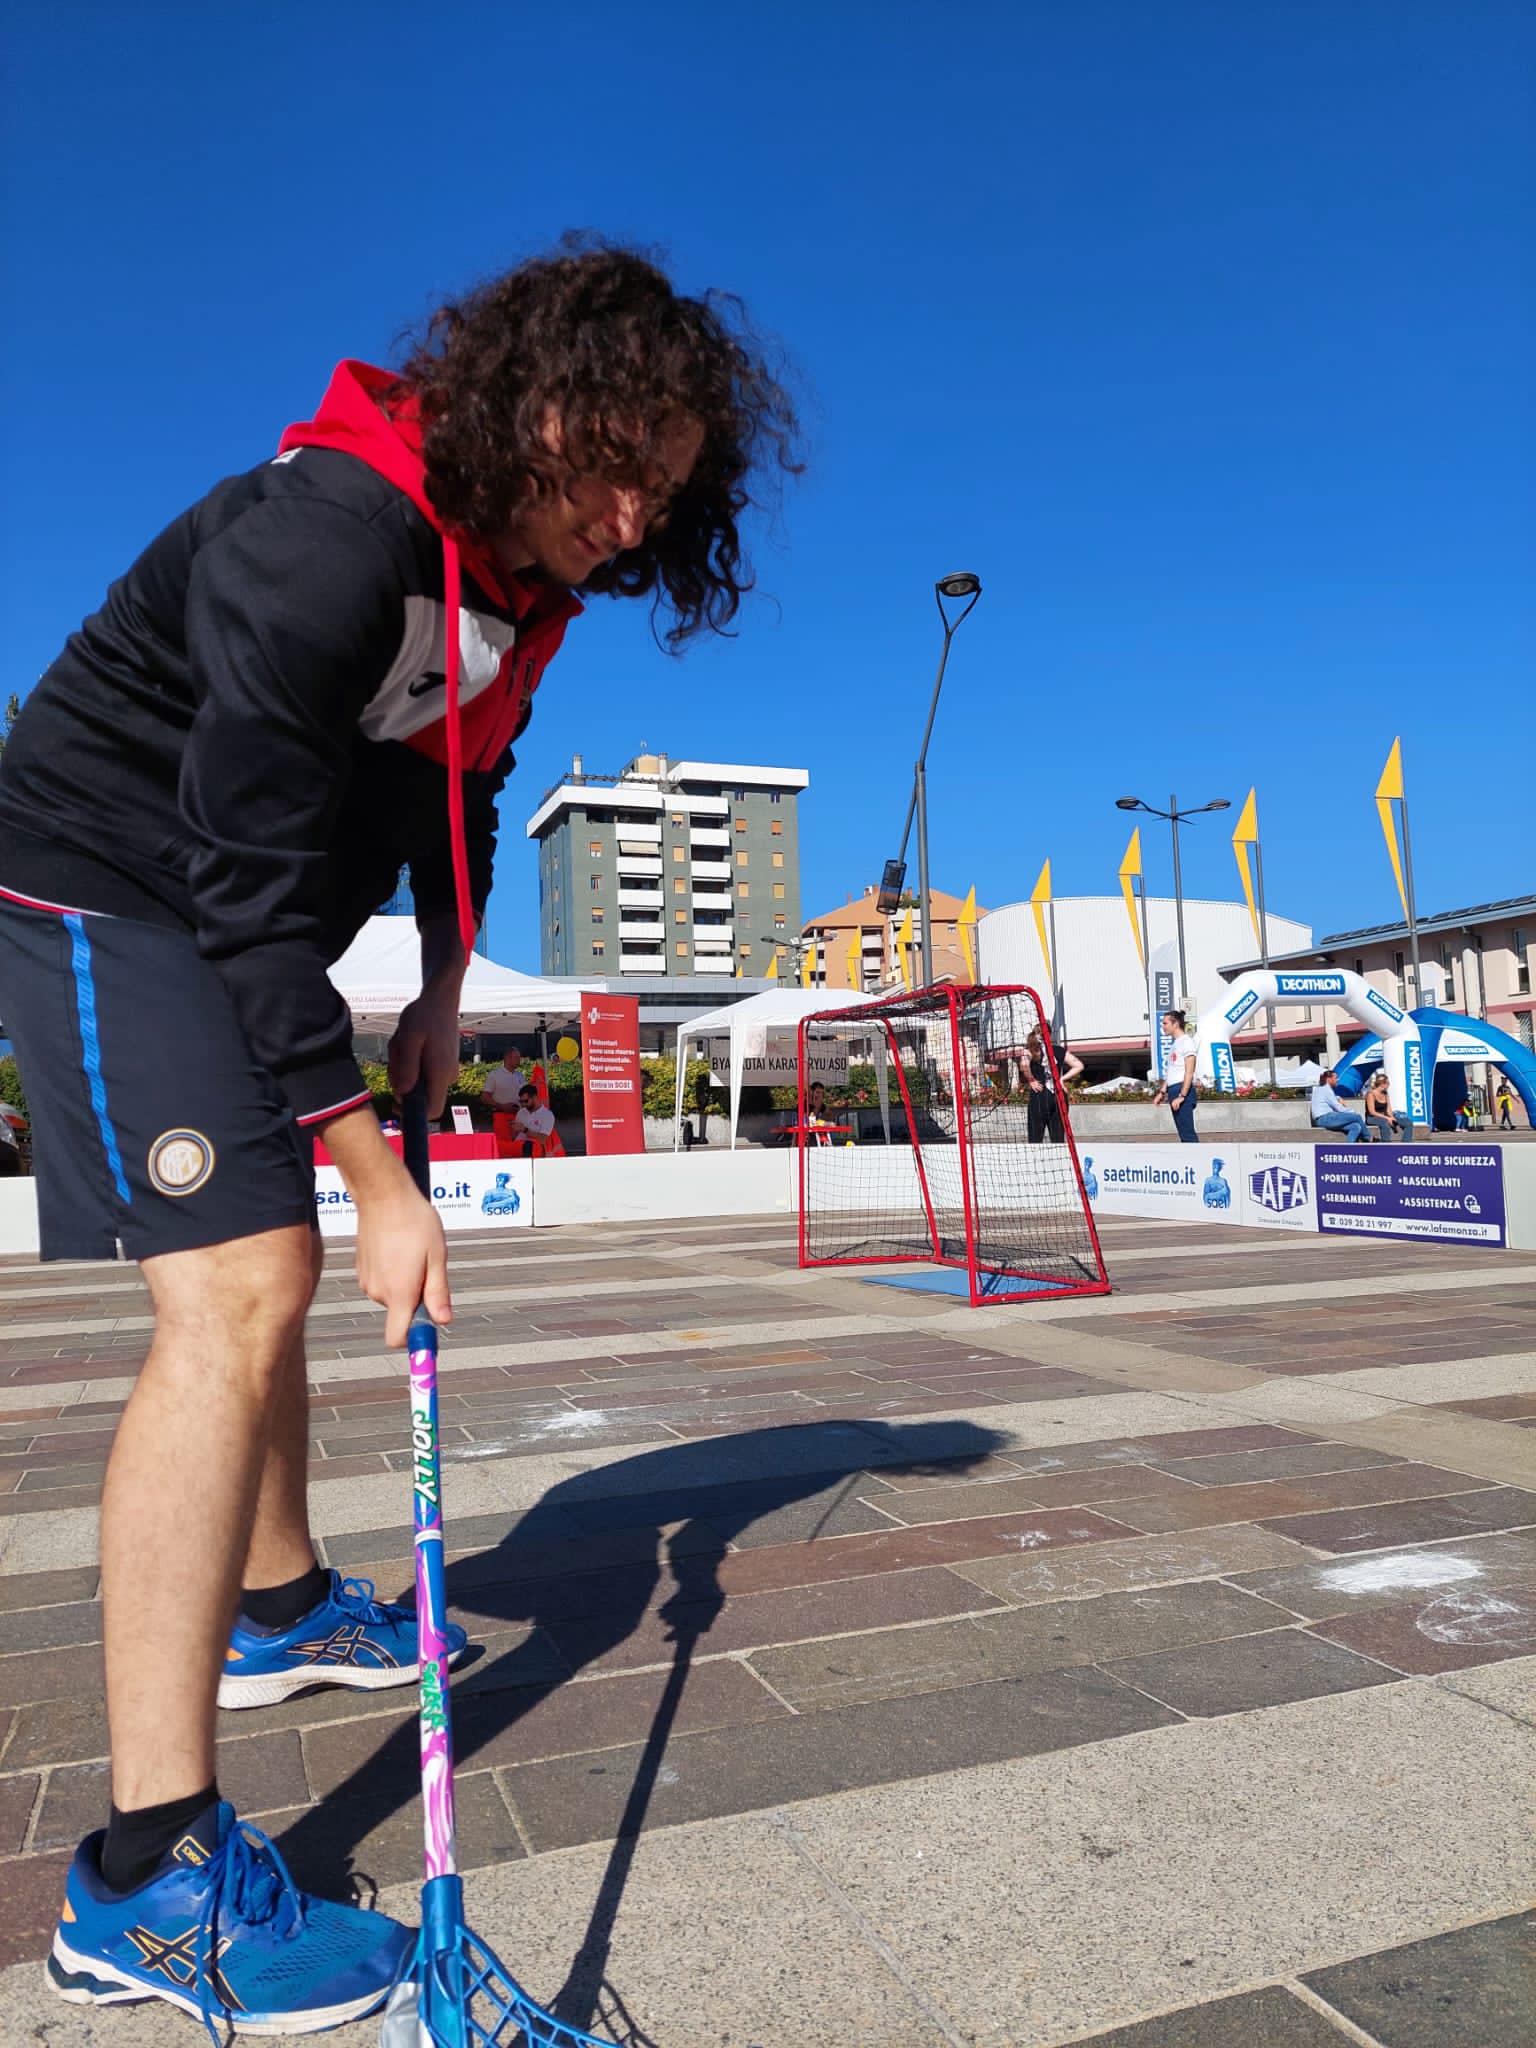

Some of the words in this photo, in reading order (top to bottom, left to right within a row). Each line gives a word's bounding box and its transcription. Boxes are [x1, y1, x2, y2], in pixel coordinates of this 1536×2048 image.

[1281, 978, 1341, 991] DECATHLON
[1159, 978, 1170, 1006] CLUB
[768, 1058, 803, 1071] KARAT
[1409, 1046, 1424, 1117] DECATHLON
[1324, 1154, 1368, 1164] SERRATURE
[1402, 1155, 1429, 1165] GRATE
[1432, 1156, 1441, 1165] DI
[1444, 1156, 1496, 1166] SICUREZZA
[1103, 1165, 1196, 1185] saetmilano.it
[1324, 1173, 1349, 1183] PORTE
[1352, 1175, 1392, 1185] BLINDATE
[1403, 1176, 1461, 1187] BASCULANTI
[1249, 1168, 1309, 1210] LAFA
[1325, 1193, 1376, 1205] SERRAMENTI
[1404, 1198, 1461, 1209] ASSISTENZA
[1378, 1221, 1392, 1230] 997
[1406, 1223, 1488, 1236] www.lafamonza.it
[413, 1412, 438, 1504] JOLLY
